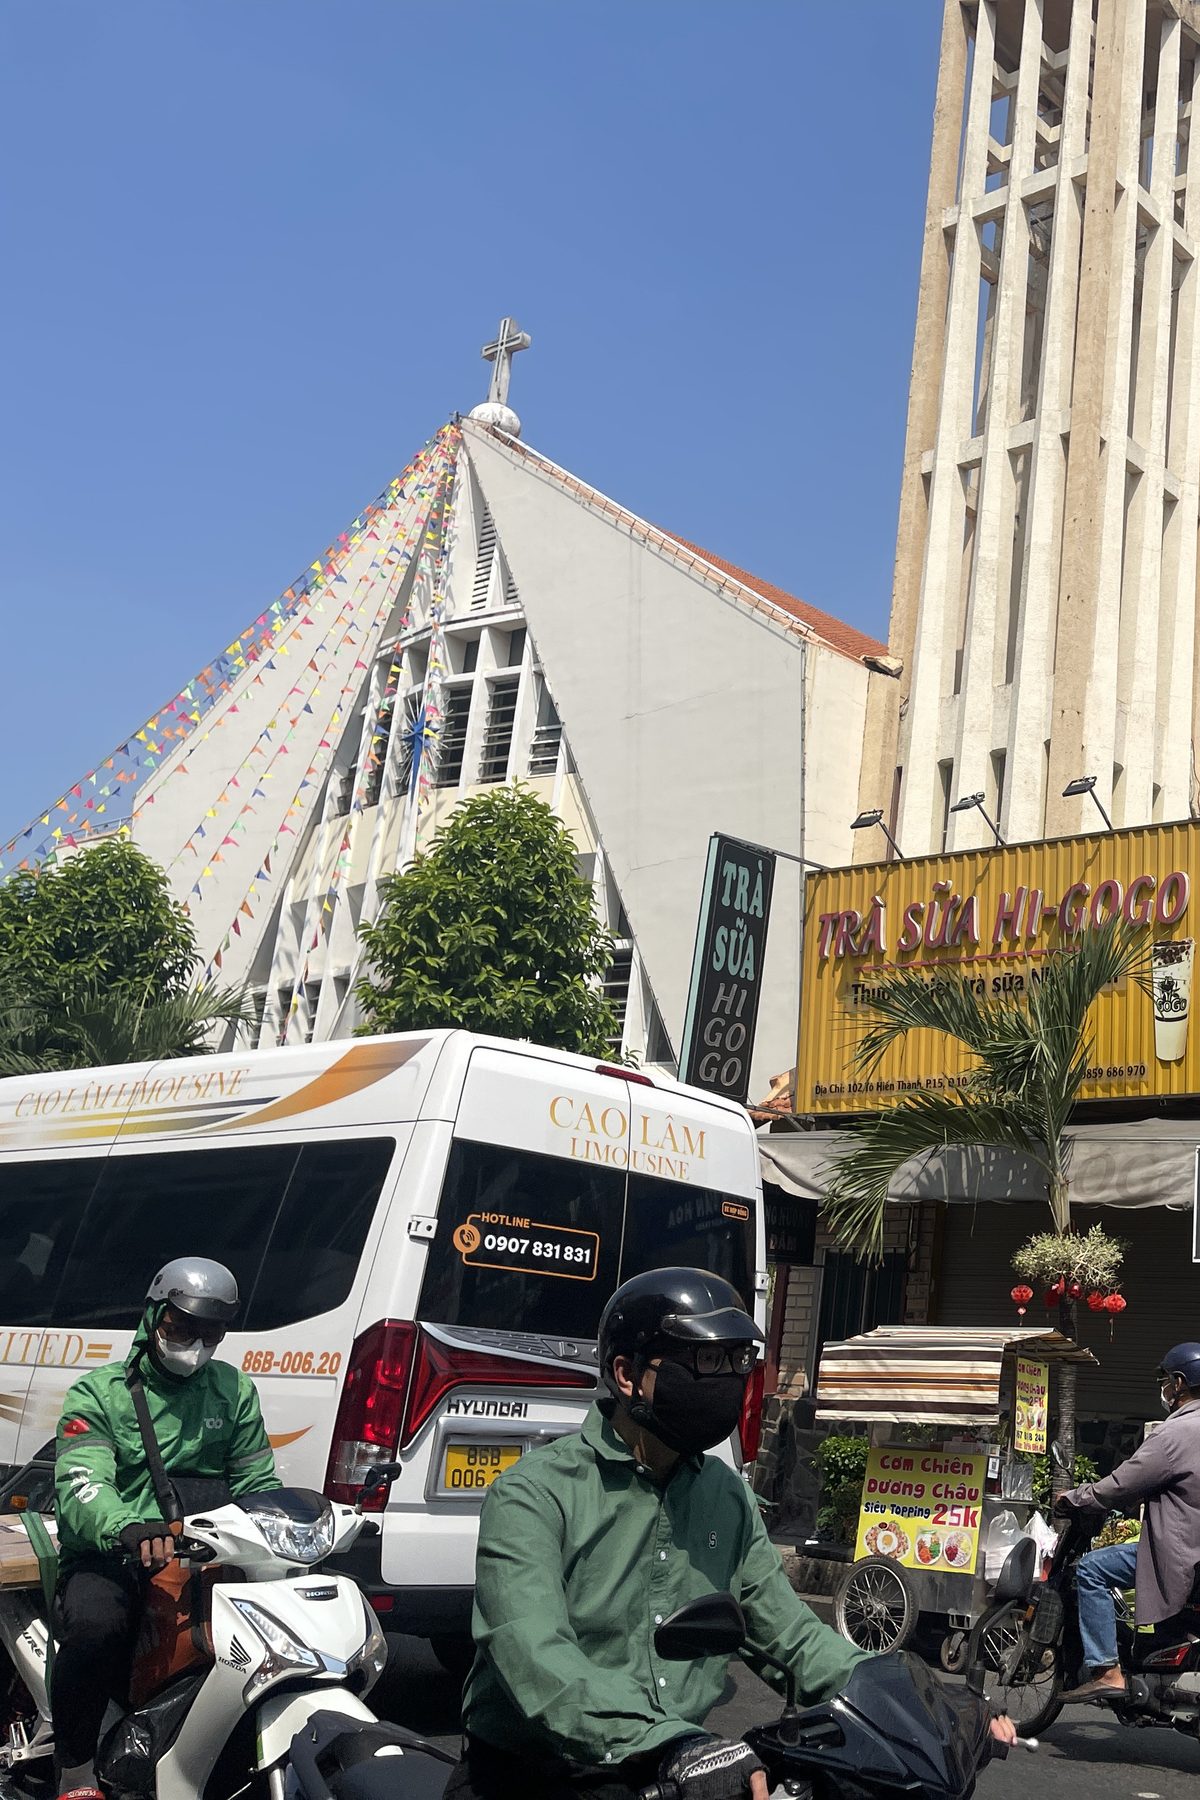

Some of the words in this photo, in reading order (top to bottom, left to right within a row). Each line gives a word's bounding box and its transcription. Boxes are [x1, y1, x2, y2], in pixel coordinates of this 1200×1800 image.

[721, 859, 763, 918] TRÀ
[819, 895, 887, 959] TRÀ
[897, 880, 981, 952] SỮA
[993, 871, 1190, 945] HI-GOGO
[713, 917, 754, 981] SỮA
[992, 972, 1024, 993] sữa
[711, 983, 748, 1018] HI
[703, 1017, 747, 1052] GO
[699, 1052, 742, 1087] GO
[1106, 1066, 1124, 1078] 686
[1127, 1065, 1146, 1076] 970
[15, 1089, 61, 1118] CAO
[112, 1068, 250, 1108] LIMOUSINE
[550, 1095, 628, 1139] CAO
[639, 1114, 706, 1160] LÂM
[570, 1137, 690, 1181] LIMOUSINE
[481, 1212, 531, 1229] HOTLINE
[484, 1234, 530, 1255] 0907
[532, 1241, 561, 1259] 831
[563, 1245, 591, 1264] 831
[0, 1332, 84, 1365] ITED
[242, 1350, 342, 1376] 86B-006.20
[447, 1400, 528, 1418] HYUNDAI
[467, 1447, 501, 1466] 86B
[879, 1454, 914, 1471] Cơm
[921, 1453, 974, 1476] Chiên
[867, 1478, 925, 1499] Dương
[932, 1483, 979, 1501] Châu
[864, 1501, 887, 1514] Siêu
[891, 1503, 931, 1519] Topping
[305, 1590, 337, 1598] HONDA
[218, 1656, 247, 1674] HONDA
